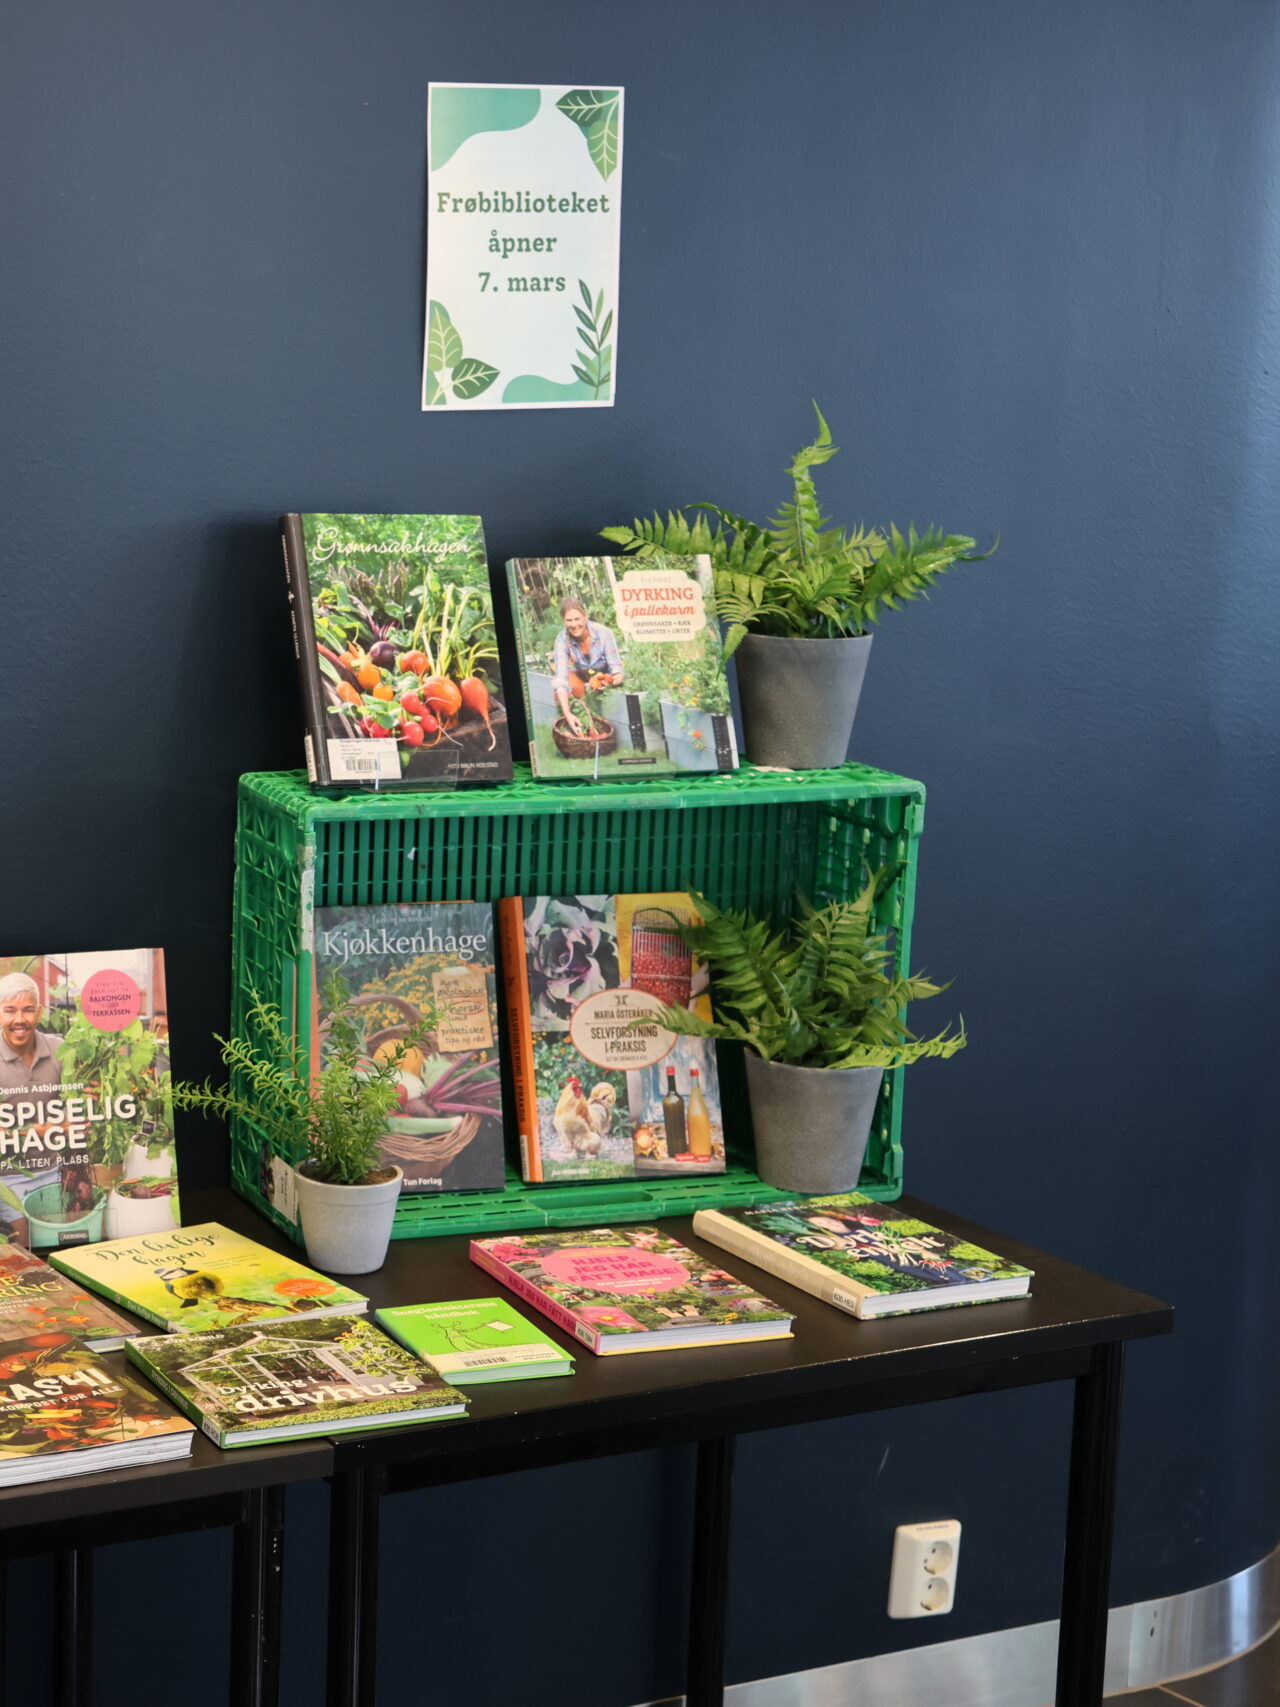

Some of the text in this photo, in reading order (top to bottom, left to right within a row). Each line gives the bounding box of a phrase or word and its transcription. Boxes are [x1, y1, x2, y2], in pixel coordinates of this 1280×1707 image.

[436, 191, 610, 213] Frøbiblioteket
[488, 229, 557, 259] åpner
[478, 272, 566, 292] 7. mars
[312, 526, 471, 563] Grønnsakhagen
[621, 587, 694, 602] DYRKING
[624, 604, 696, 619] i pallekarm
[322, 927, 487, 965] Kjøkkenhage
[89, 994, 131, 1003] BALKONGEN
[93, 1009, 131, 1017] TERRASSEN
[594, 1007, 653, 1019] MARIA ÖSTERÅKER
[591, 1025, 658, 1040] SELVFORSYNING
[610, 1040, 647, 1053] PRAKSIS
[31, 1081, 84, 1094] Asbjørnsen
[0, 1124, 88, 1155] HAGE
[0, 1154, 89, 1171] PÅ LITEN PLASS
[403, 1176, 443, 1187] Tun Forlag
[90, 1228, 229, 1262] Den livlige
[796, 1228, 890, 1250] Dyrk
[847, 1234, 945, 1258] enkelt
[130, 1245, 213, 1270] hagen
[569, 1255, 638, 1266] HJELP,
[562, 1267, 685, 1282] FÅTT HAGE!
[568, 1261, 658, 1274] JEG HAR
[833, 1291, 844, 1304] 635
[58, 1392, 90, 1402] FOR
[87, 1385, 126, 1396] ALLE
[215, 1377, 308, 1395] Dyrking
[225, 1375, 421, 1413] drivhus
